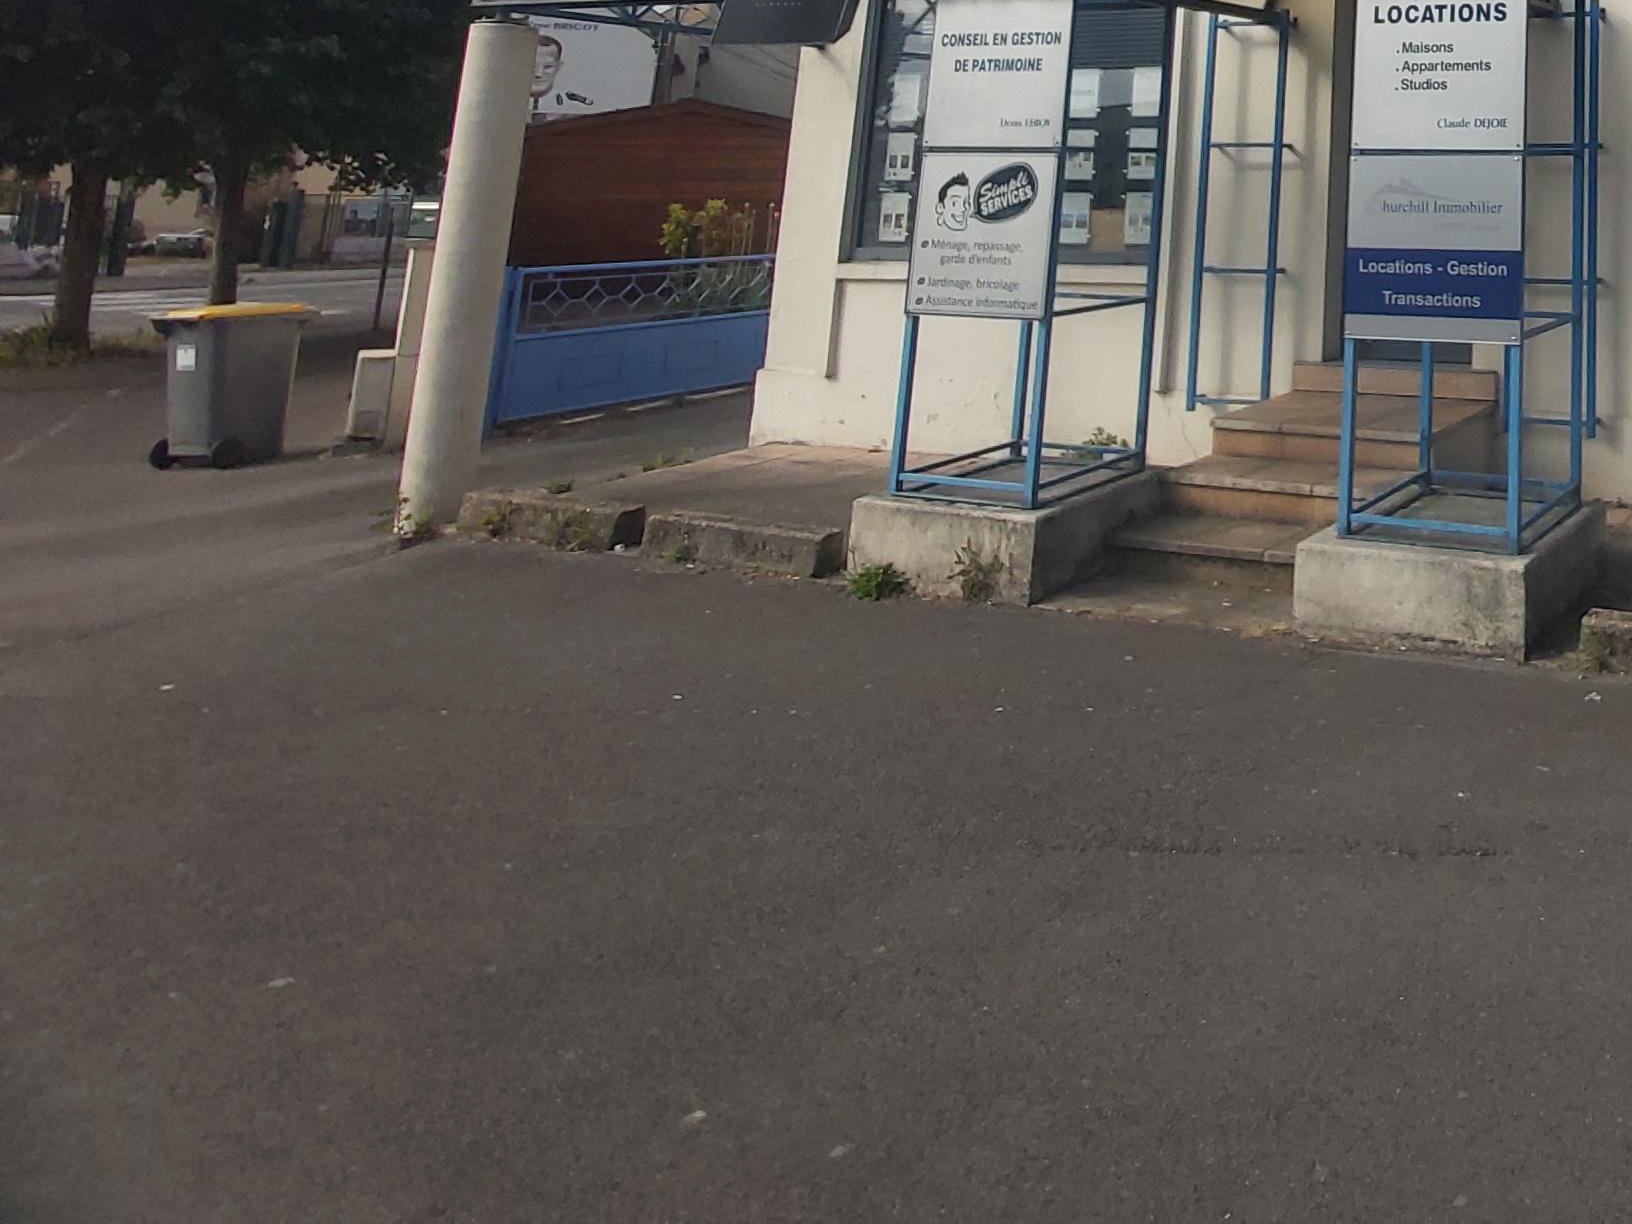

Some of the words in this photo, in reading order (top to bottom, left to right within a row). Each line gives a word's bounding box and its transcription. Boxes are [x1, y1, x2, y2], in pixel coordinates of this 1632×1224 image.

[1374, 2, 1507, 24] LOCATIONS
[941, 33, 989, 47] CONSEIL
[993, 33, 1007, 46] EN
[1012, 31, 1062, 46] GESTION
[954, 59, 969, 72] DE
[972, 58, 1043, 72] PATRIMOINE
[1437, 118, 1470, 129] Claude
[980, 185, 1033, 216] SERVICES
[1433, 199, 1503, 215] Immobilier
[1358, 258, 1433, 274] Locations
[1447, 259, 1507, 276] Gestion
[1382, 290, 1481, 308] Transactions
